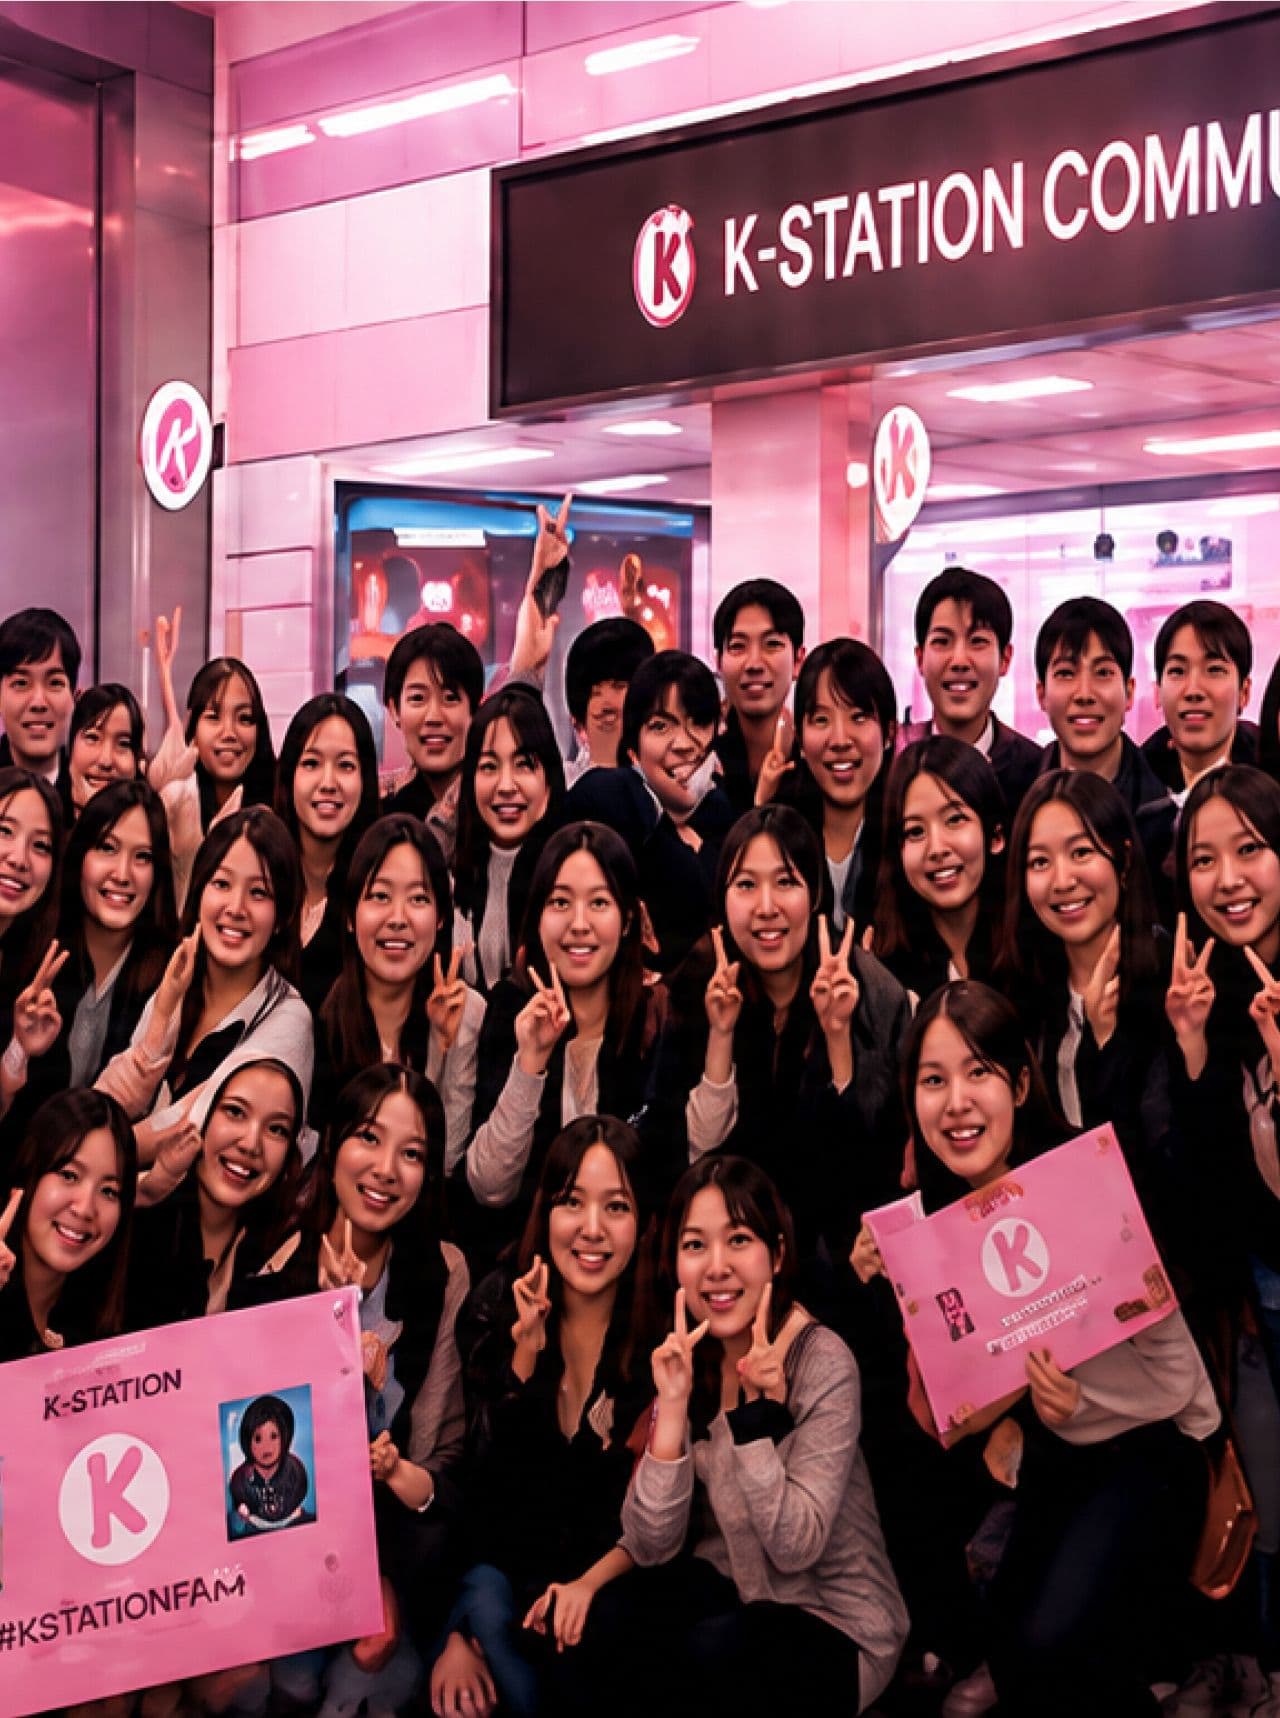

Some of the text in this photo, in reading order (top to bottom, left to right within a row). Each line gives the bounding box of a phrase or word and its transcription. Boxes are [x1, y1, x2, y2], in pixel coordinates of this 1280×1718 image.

[653, 231, 682, 306] K
[724, 161, 1025, 295] K-STATION
[991, 1223, 1044, 1293] K
[42, 1369, 182, 1421] K-STATION
[86, 1445, 148, 1549] K
